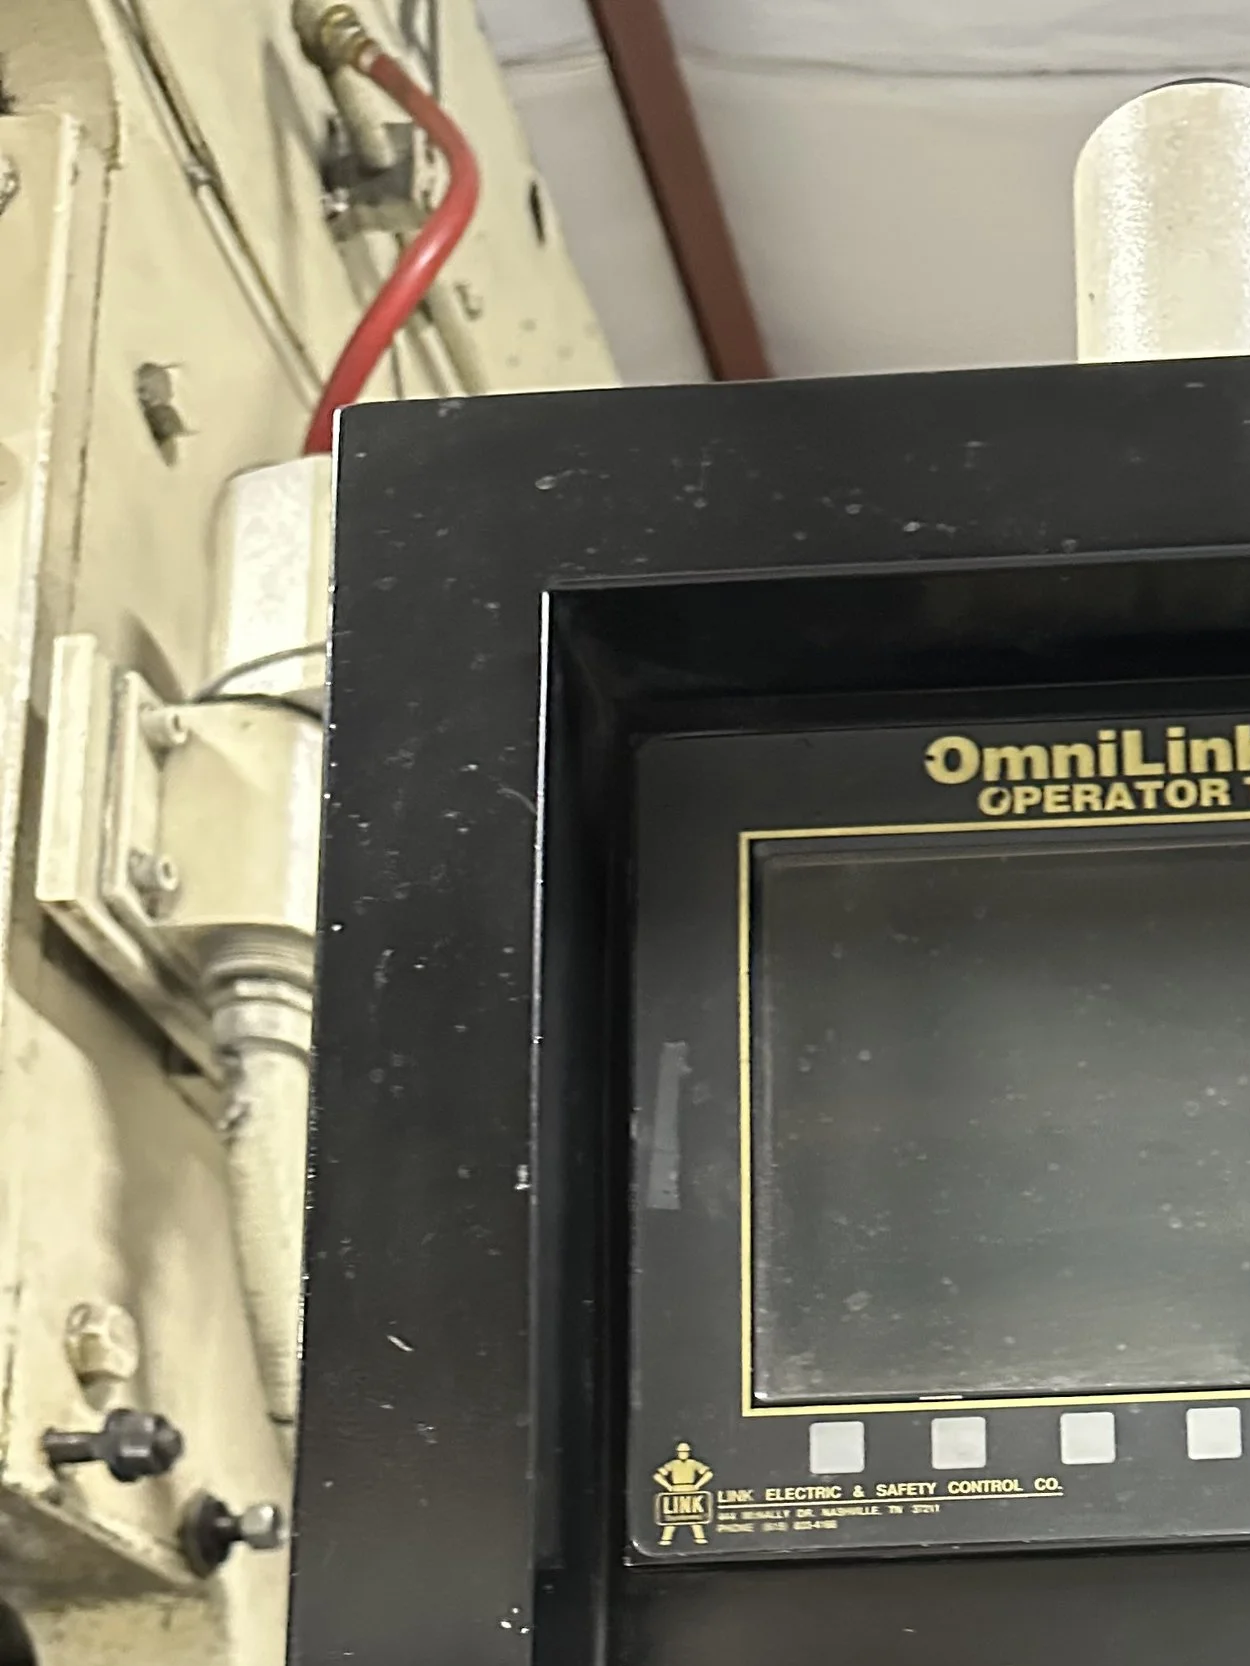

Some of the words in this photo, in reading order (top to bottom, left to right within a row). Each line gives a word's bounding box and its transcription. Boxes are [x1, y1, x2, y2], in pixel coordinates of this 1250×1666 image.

[977, 777, 1231, 816] OPERATOR
[718, 1489, 754, 1503] LINK
[765, 1485, 842, 1500] ELECTRIC
[853, 1484, 865, 1498] &
[876, 1481, 937, 1498] SAFETY
[948, 1477, 1023, 1495] CONTROL
[1034, 1476, 1063, 1491] CO.
[662, 1495, 705, 1515] LINK
